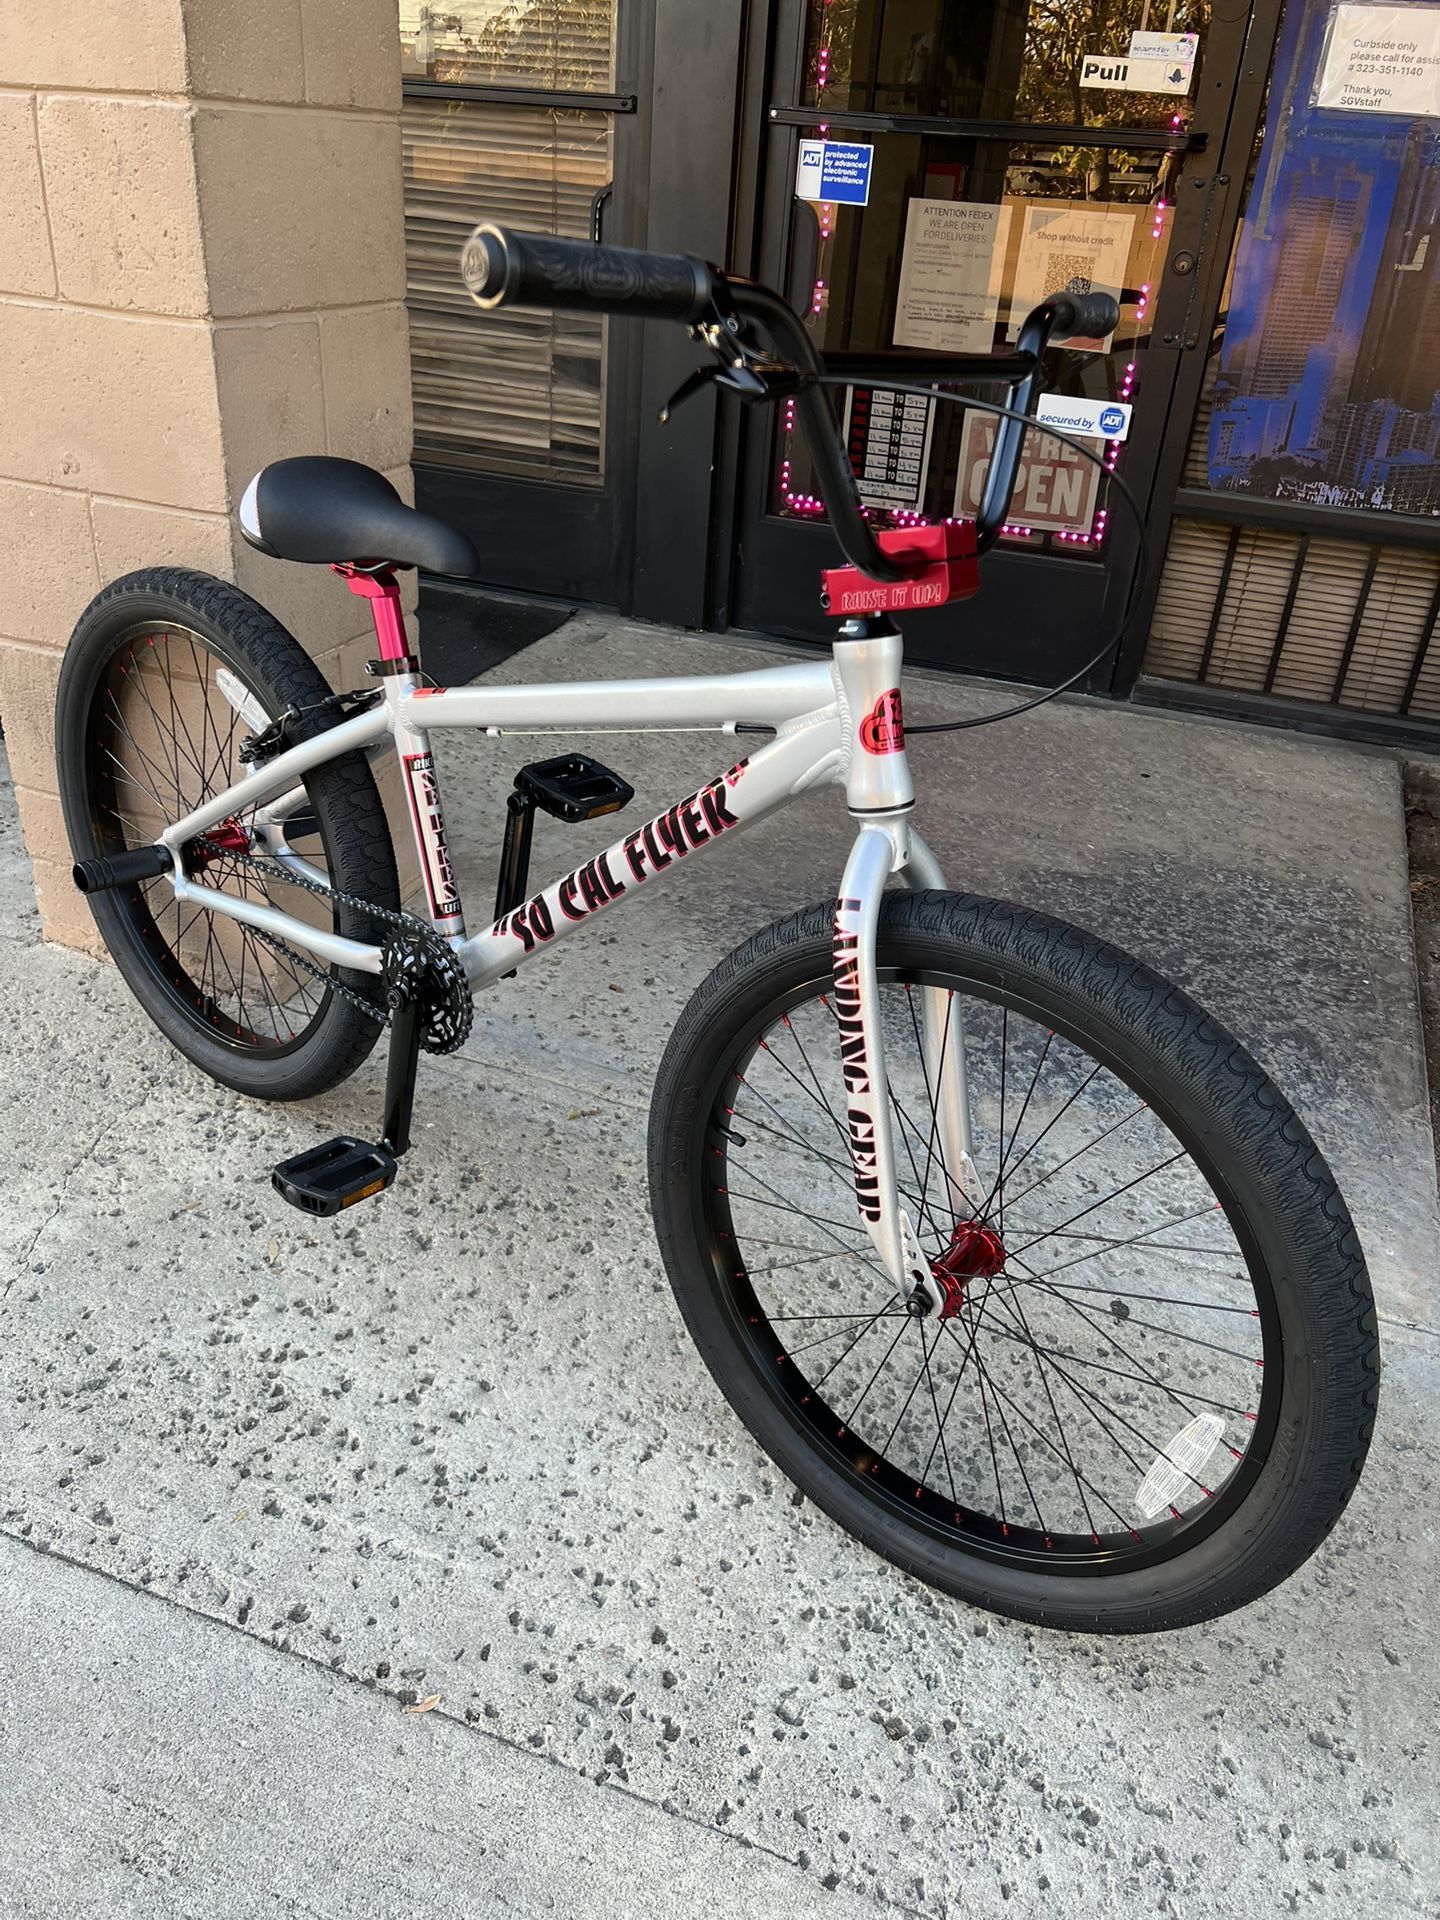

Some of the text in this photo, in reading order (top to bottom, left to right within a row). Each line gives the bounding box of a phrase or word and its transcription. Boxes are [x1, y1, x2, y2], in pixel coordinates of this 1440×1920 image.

[1353, 38, 1418, 53] Curbside only
[1350, 51, 1381, 61] please
[1382, 53, 1399, 62] call
[1401, 54, 1415, 63] for
[1084, 62, 1128, 81] Pull
[1356, 63, 1424, 76] 323-351-1140
[1343, 84, 1392, 98] Thank you,
[803, 153, 821, 165] ADT
[824, 152, 859, 160] protected
[824, 159, 869, 169] by advanced
[823, 167, 858, 176] electronic
[822, 175, 864, 185] surveillance
[923, 207, 993, 220] ATTENTION FEDEX
[929, 219, 984, 231] WE ARE OPEN
[1037, 231, 1115, 246] Shop without credit
[896, 395, 904, 403] TO
[895, 408, 902, 416] TO
[893, 421, 901, 429] TO
[1039, 413, 1095, 429] secured by
[1102, 413, 1123, 427] ADT
[892, 433, 899, 442] TO
[890, 446, 898, 455] TO
[889, 459, 896, 467] TO
[887, 471, 895, 480] TO
[842, 583, 942, 611] RAISE IT UP!
[429, 813, 458, 900] BIKES
[558, 850, 626, 921] CAL
[833, 898, 881, 1223] LANDING GEAR
